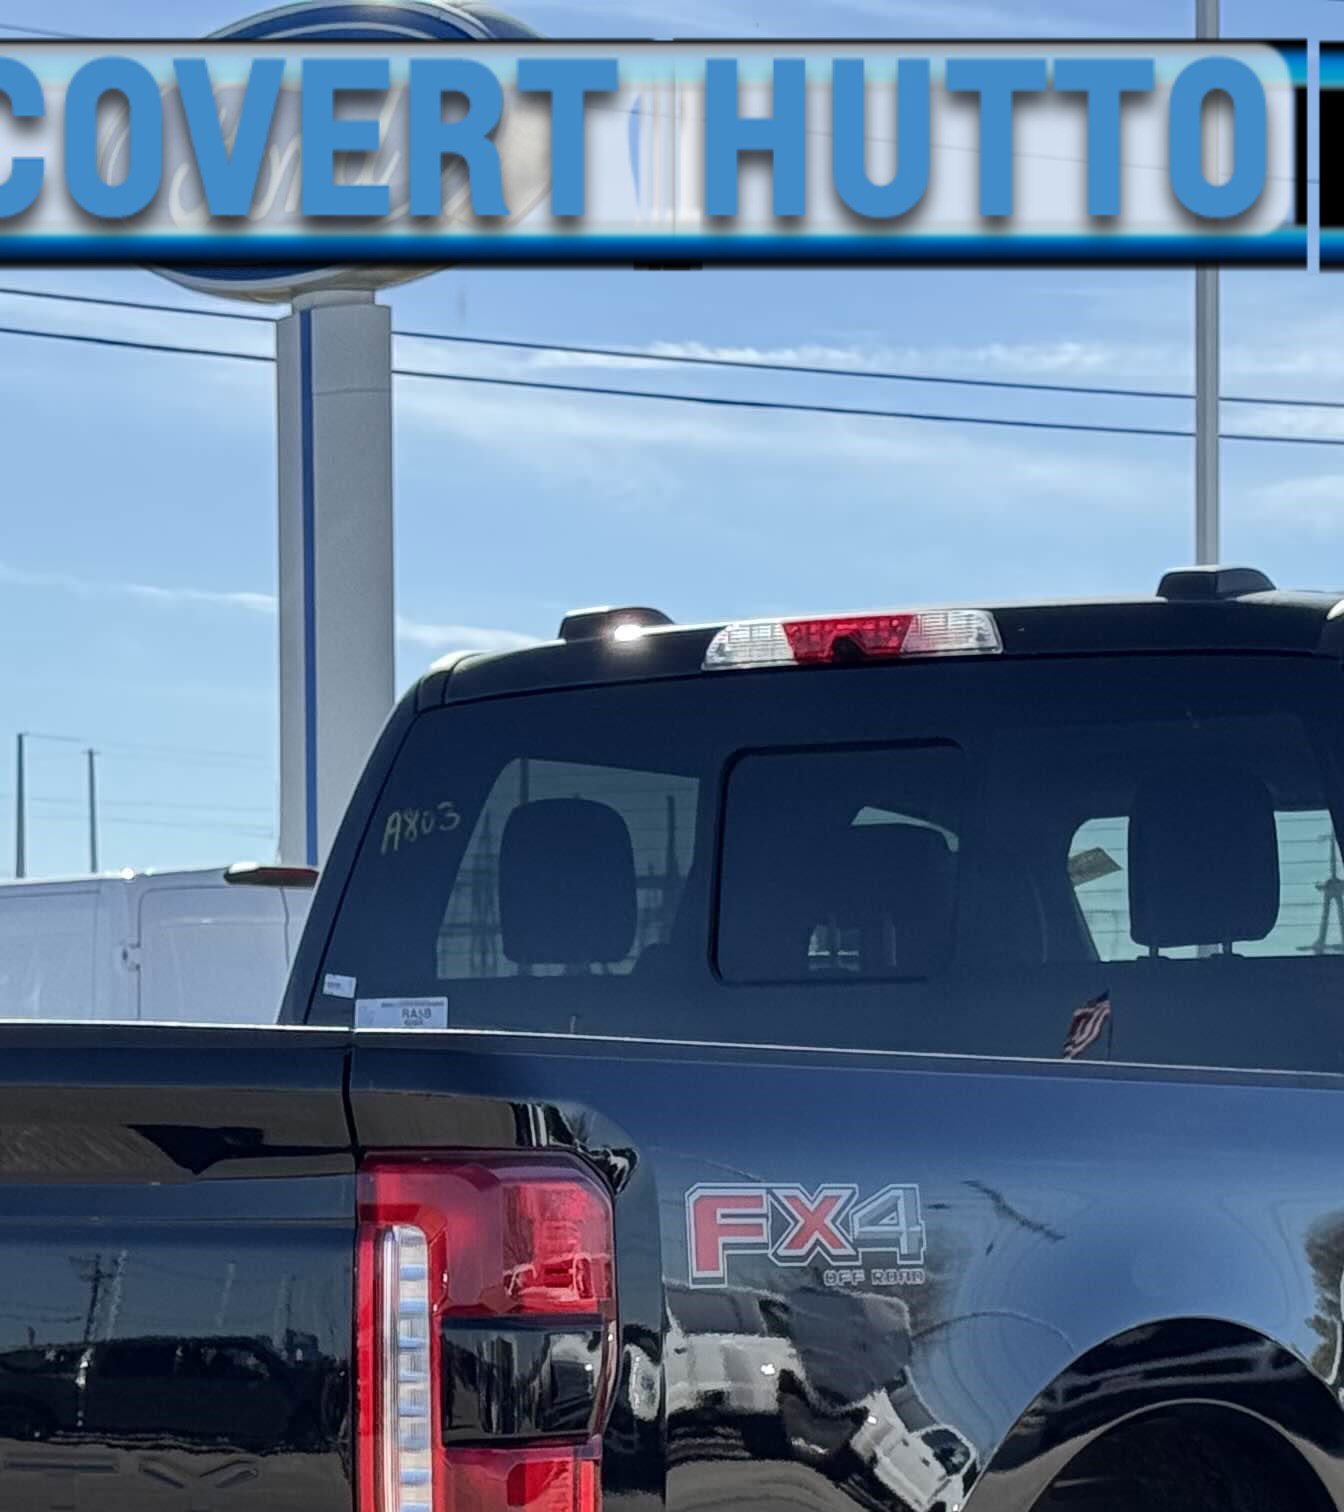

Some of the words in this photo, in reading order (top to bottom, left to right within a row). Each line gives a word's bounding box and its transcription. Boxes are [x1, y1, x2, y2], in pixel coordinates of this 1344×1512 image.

[684, 1182, 928, 1289] FX4
[823, 1269, 865, 1286] OFF
[871, 1268, 926, 1286] ROAD
